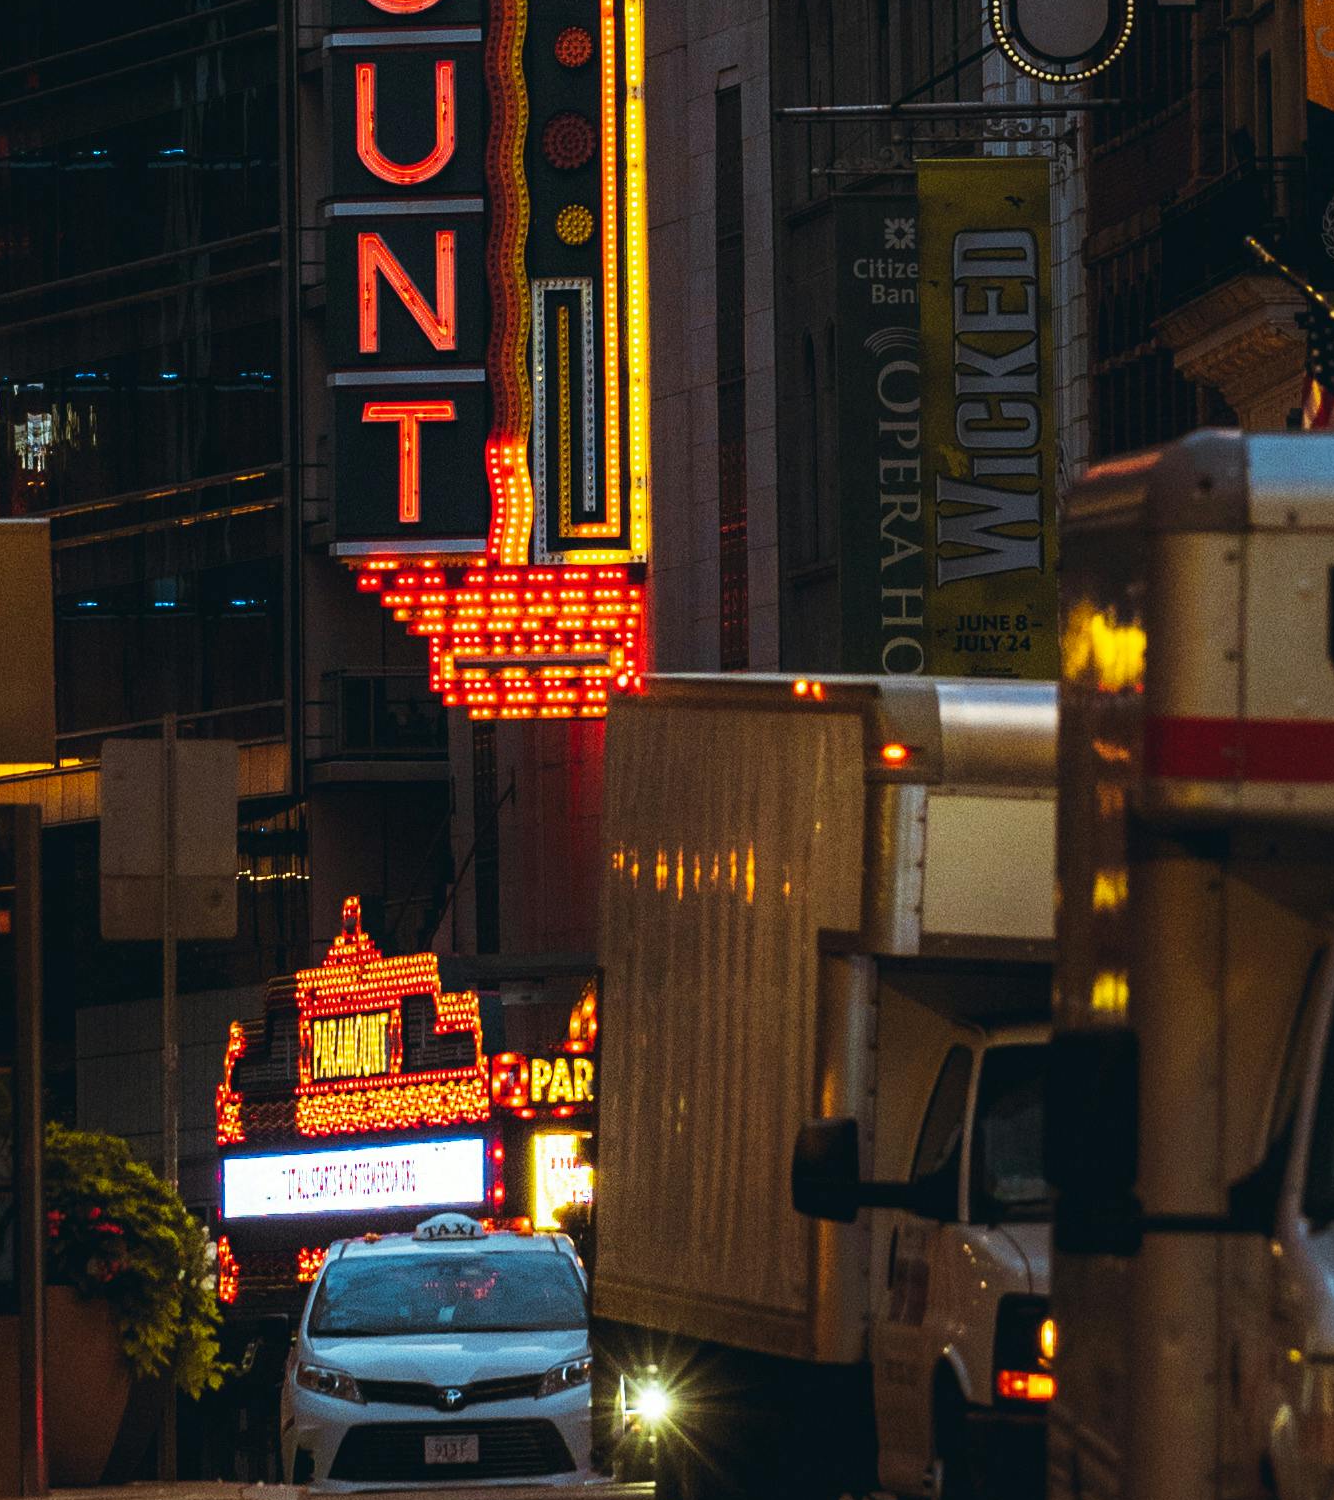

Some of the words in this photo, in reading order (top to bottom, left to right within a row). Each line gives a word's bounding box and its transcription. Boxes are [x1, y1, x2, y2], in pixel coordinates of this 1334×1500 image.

[871, 284, 920, 305] Ban
[936, 227, 1045, 588] WICKED
[876, 359, 923, 573] OPERA
[954, 614, 1010, 632] JUNE
[953, 634, 1001, 652] JULY
[1007, 633, 1031, 652] 24
[312, 1011, 391, 1080] PARAMOUNT
[423, 1222, 477, 1239] TAXI
